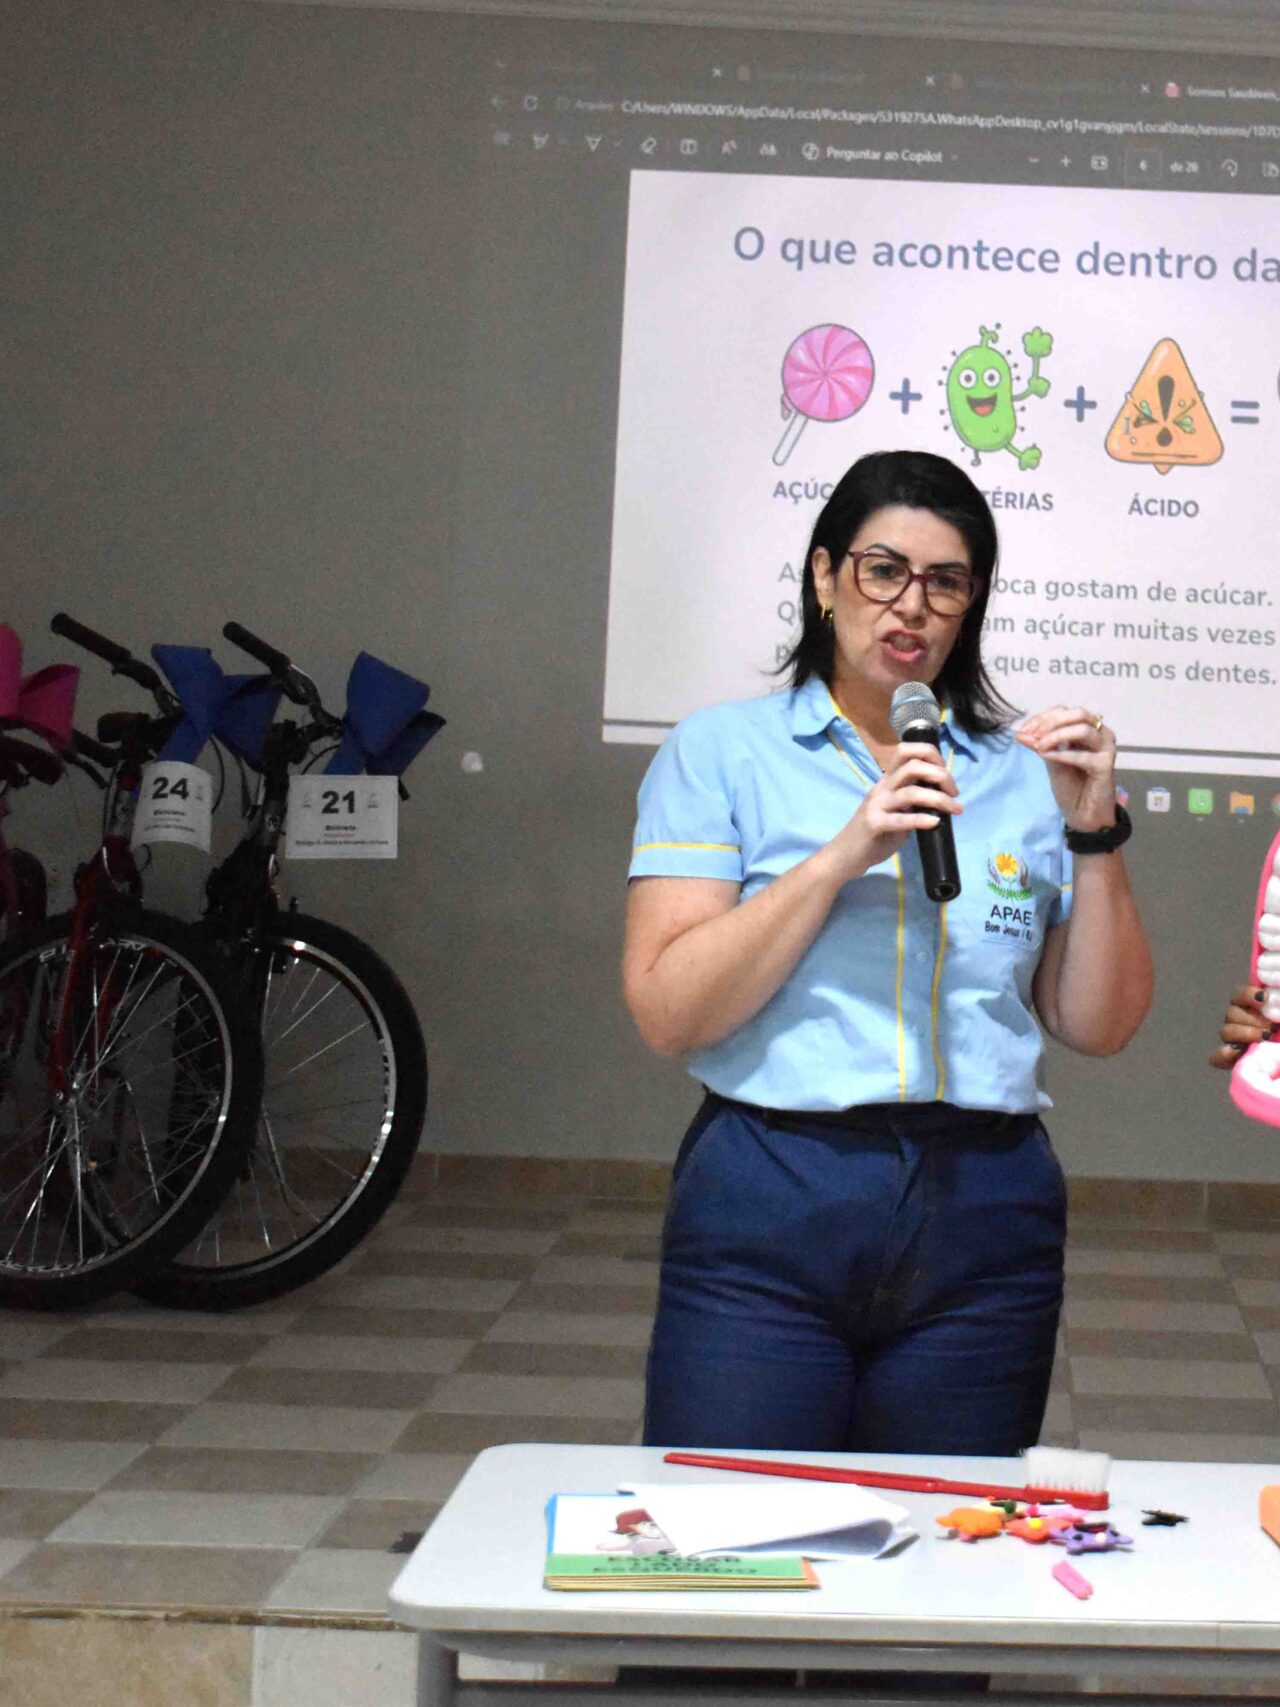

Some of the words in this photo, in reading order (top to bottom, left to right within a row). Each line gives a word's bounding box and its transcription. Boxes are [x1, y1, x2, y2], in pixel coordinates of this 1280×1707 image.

[826, 146, 881, 162] Perguntar
[884, 151, 899, 161] ao
[901, 149, 943, 164] Copilot
[733, 226, 765, 262] O
[780, 236, 857, 271] que
[872, 239, 1062, 274] acontece
[1075, 241, 1218, 280] dentro
[772, 479, 833, 504] AÇÚC
[1127, 493, 1200, 519] ÁCIDO
[993, 578, 1036, 595] oca
[1044, 578, 1138, 601] gostam
[1146, 580, 1177, 603] de
[1185, 581, 1273, 607] açúcar.
[1024, 613, 1106, 640] açúcar
[1113, 618, 1199, 643] muitas
[1206, 627, 1276, 647] vezes
[993, 655, 1040, 677] que
[1048, 655, 1140, 679] atacam
[1147, 663, 1177, 681] os
[1184, 660, 1277, 686] dentes.
[152, 776, 189, 800] 24
[322, 790, 356, 814] 21
[990, 904, 1033, 926] APAE
